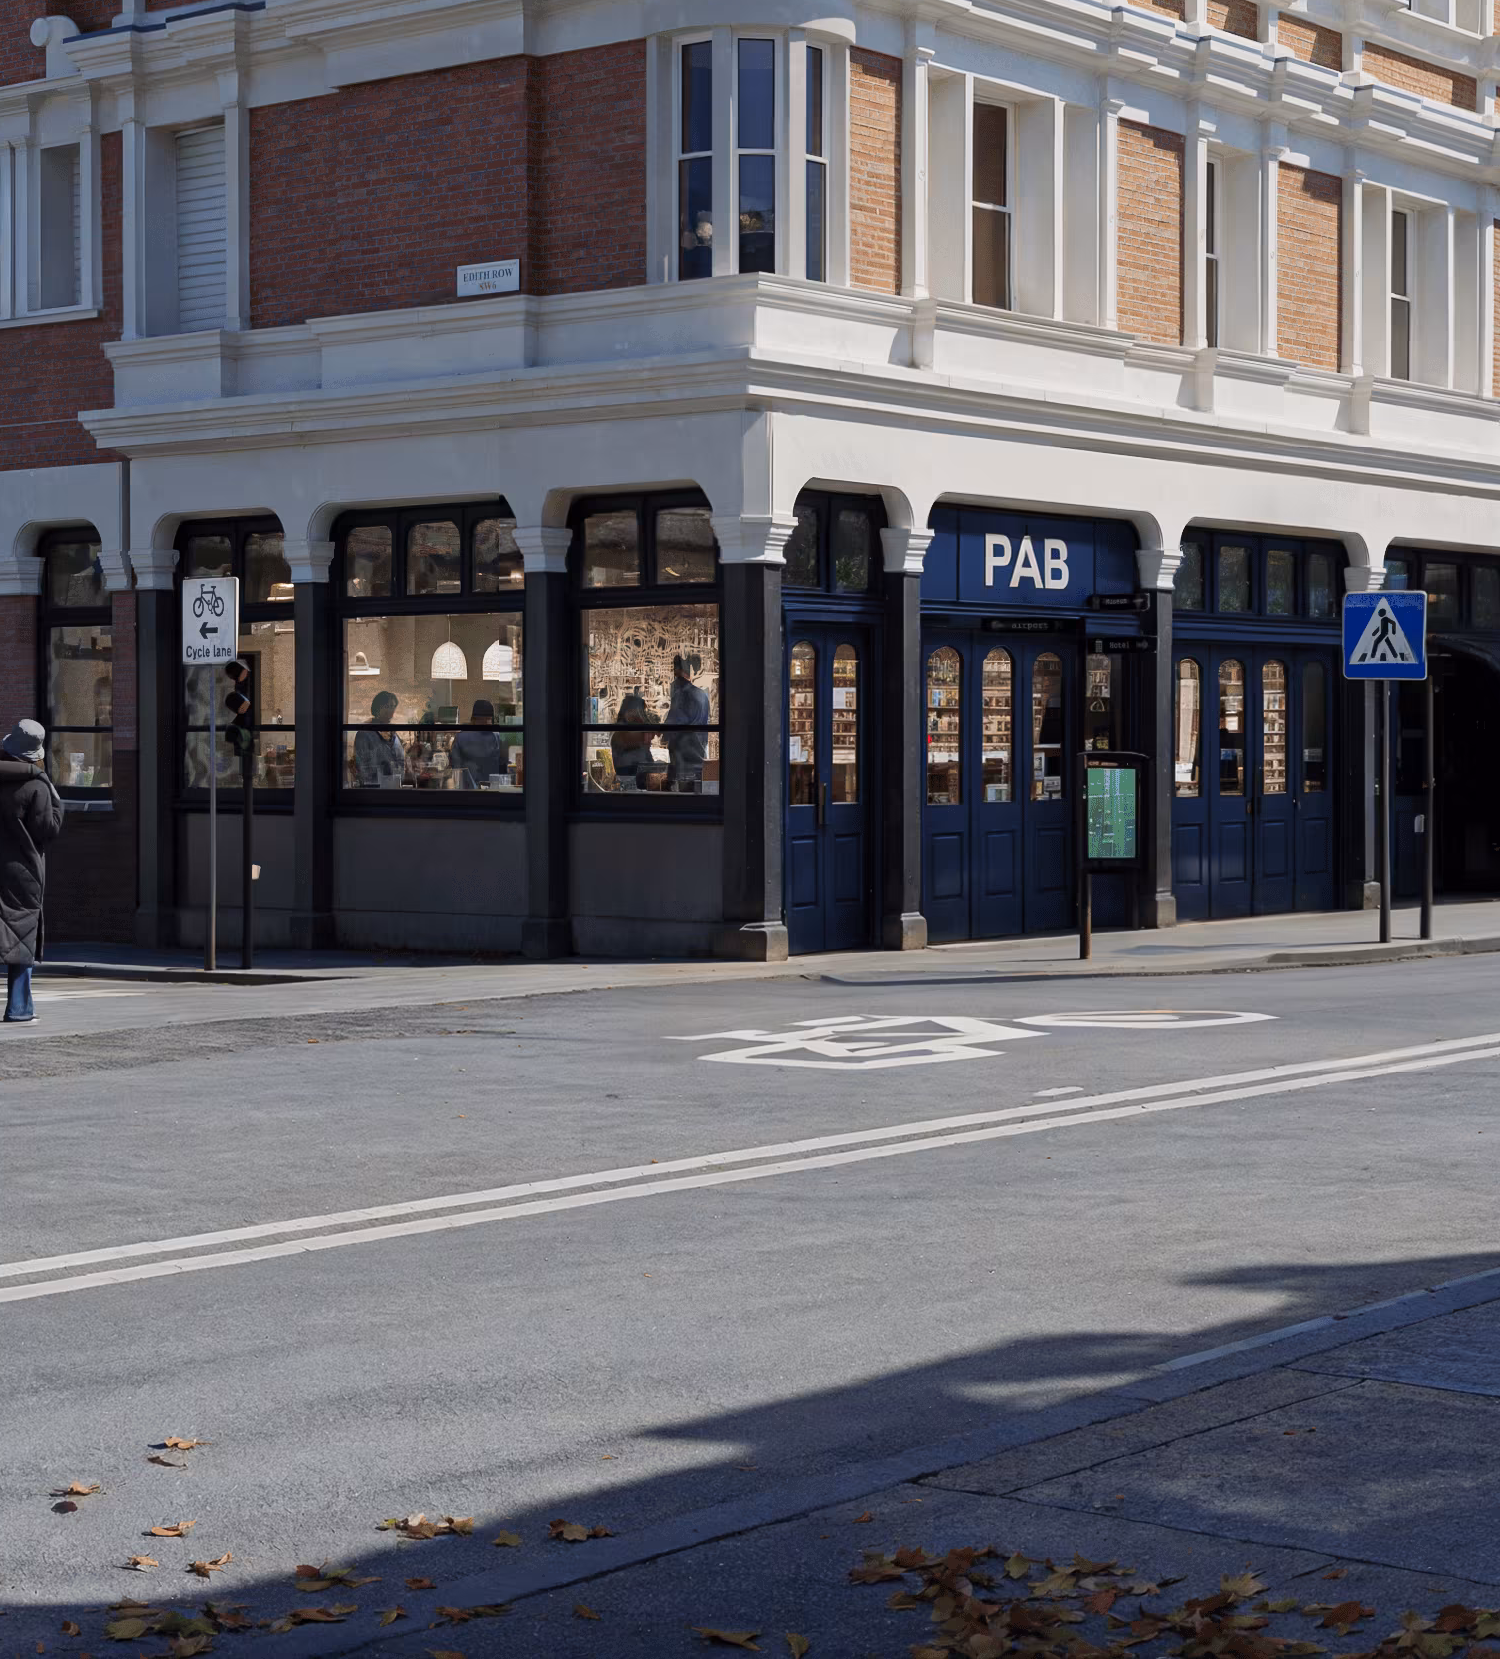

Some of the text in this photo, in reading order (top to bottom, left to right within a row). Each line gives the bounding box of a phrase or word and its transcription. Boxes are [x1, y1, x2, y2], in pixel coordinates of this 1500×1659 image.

[463, 268, 513, 282] EDITH ROW
[985, 533, 1069, 590] PAB
[186, 645, 232, 660] Cycle lane
